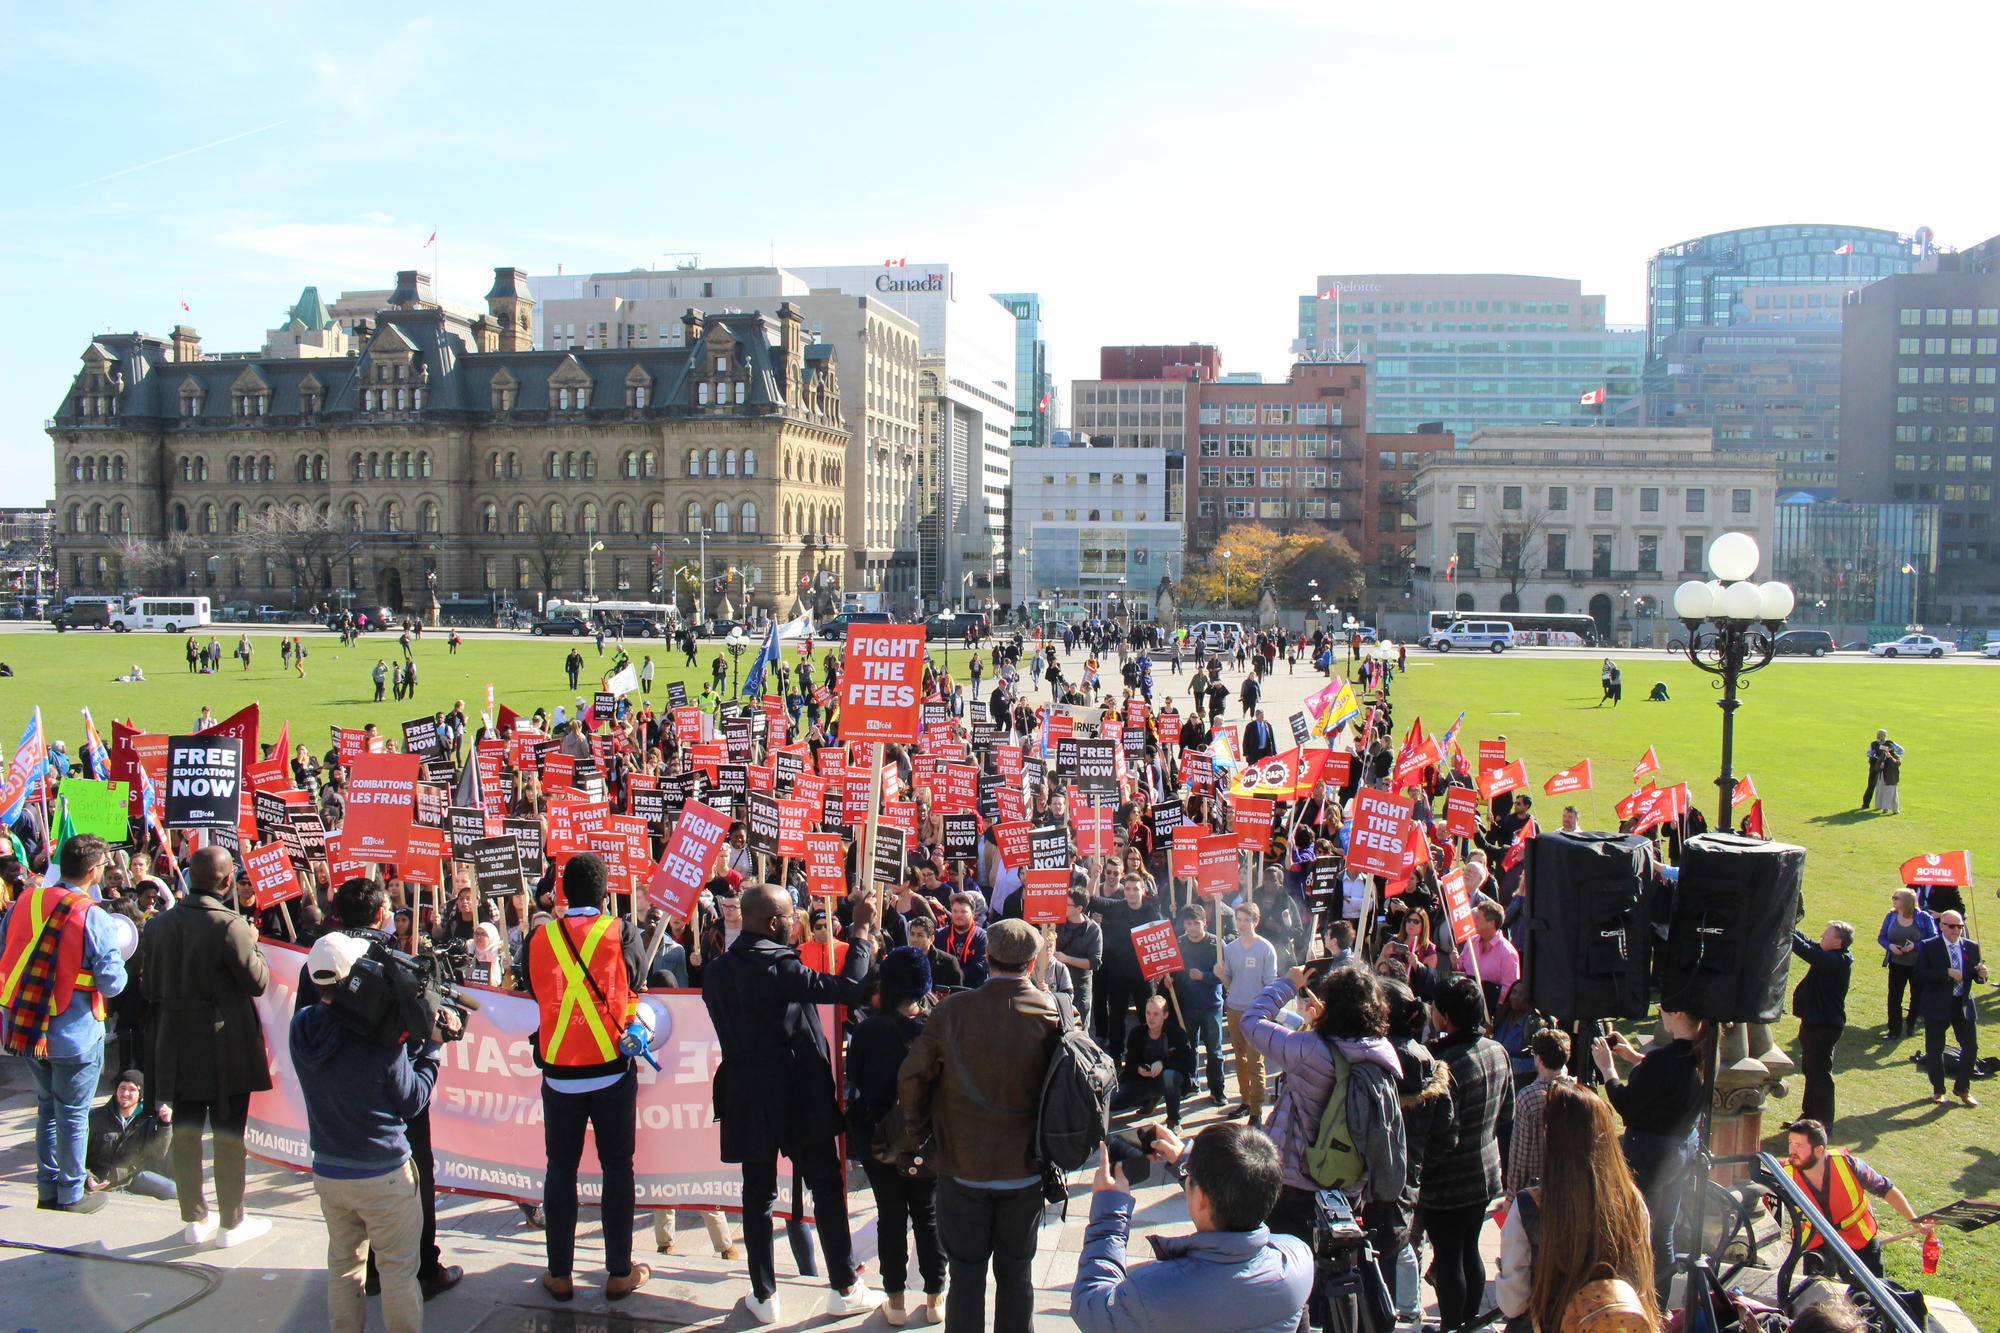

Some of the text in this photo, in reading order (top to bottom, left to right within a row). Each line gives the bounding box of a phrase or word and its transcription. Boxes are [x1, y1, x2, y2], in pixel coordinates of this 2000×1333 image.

[876, 274, 943, 292] Canada
[853, 638, 919, 657] FIGHT
[862, 661, 905, 681] THE
[849, 684, 915, 707] FEES
[405, 722, 435, 737] FREE
[727, 730, 748, 738] FREE
[343, 733, 365, 742] FIGHT
[409, 737, 437, 753] NOW
[728, 742, 749, 751] NOW
[174, 748, 237, 767] FREE
[820, 752, 844, 760] FIGHT
[943, 748, 963, 756] FIGHT
[999, 749, 1020, 758] FIGHT
[1080, 747, 1113, 758] FREE
[778, 757, 803, 768] FREE
[1003, 758, 1017, 766] THE
[1192, 760, 1212, 771] FREE
[173, 768, 235, 778] EDUCATION
[720, 771, 744, 779] FREE
[750, 771, 770, 780] FIGHT
[822, 768, 845, 776] FEES
[948, 769, 976, 780] FIGHT
[1000, 766, 1020, 775] FEES
[1080, 766, 1113, 777] NOW
[352, 780, 414, 790] COMBATTONS
[630, 779, 656, 789] FIGHT
[754, 780, 768, 789] THE
[797, 779, 824, 790] FIGHT
[953, 779, 970, 788] THE
[1193, 774, 1213, 785] NOW
[172, 779, 236, 797] NOW
[801, 788, 818, 798] THE
[949, 787, 975, 797] FEES
[350, 792, 411, 805] LES FRAIS
[418, 794, 440, 805] FREE
[634, 796, 662, 806] FREE
[708, 797, 732, 806] FREE
[998, 792, 1020, 803] FIGHT
[258, 798, 284, 811] FREE
[1003, 802, 1018, 811] THE
[1361, 797, 1409, 820] FIGHT
[1459, 806, 1475, 814] FRAIS
[572, 808, 608, 821] FIGHT
[753, 802, 778, 819] FREE
[889, 808, 916, 816] FIGHT
[1002, 809, 1024, 820] FEES
[1154, 807, 1181, 820] FREE
[1236, 810, 1270, 818] COMBATTONS
[257, 811, 283, 824] NOW
[420, 811, 441, 825] NOW
[452, 815, 483, 828] FREE
[635, 812, 662, 822] NOW
[1249, 817, 1270, 825] FRAIS
[295, 822, 321, 831] FREE
[580, 821, 603, 832] THE
[614, 822, 645, 834] FIGHT
[681, 812, 724, 844] FIGHT
[780, 818, 801, 828] THE
[946, 821, 975, 830] FREE
[1367, 815, 1398, 835] THE
[506, 828, 539, 840] FREE
[752, 821, 778, 839] NOW
[998, 826, 1031, 838] FIGHT
[275, 831, 298, 843] FREE
[946, 837, 975, 846] NOW
[1006, 836, 1029, 846] THE
[1355, 830, 1402, 854] FEES
[216, 836, 238, 850] NOW
[301, 838, 325, 848] NOW
[591, 840, 625, 852] FIGHT
[807, 841, 839, 852] FIGHT
[1032, 836, 1066, 851] FREE
[416, 848, 440, 856] FRAIS
[485, 845, 516, 855] GRATUITÉ
[679, 835, 707, 863] THE
[1033, 848, 1066, 859] EDUCATION
[1199, 848, 1237, 858] COMBATTONS
[248, 848, 284, 869] FIGHT
[480, 854, 513, 863] SCOLAIRE
[814, 853, 835, 864] THE
[1034, 855, 1066, 869] NOW
[1199, 855, 1237, 866] LES FRAIS
[258, 861, 283, 877] THE
[332, 861, 367, 873] FEES
[663, 853, 704, 888] FEES
[810, 866, 842, 878] FEES
[478, 868, 519, 878] MAINTENANT
[256, 870, 293, 892] FEES
